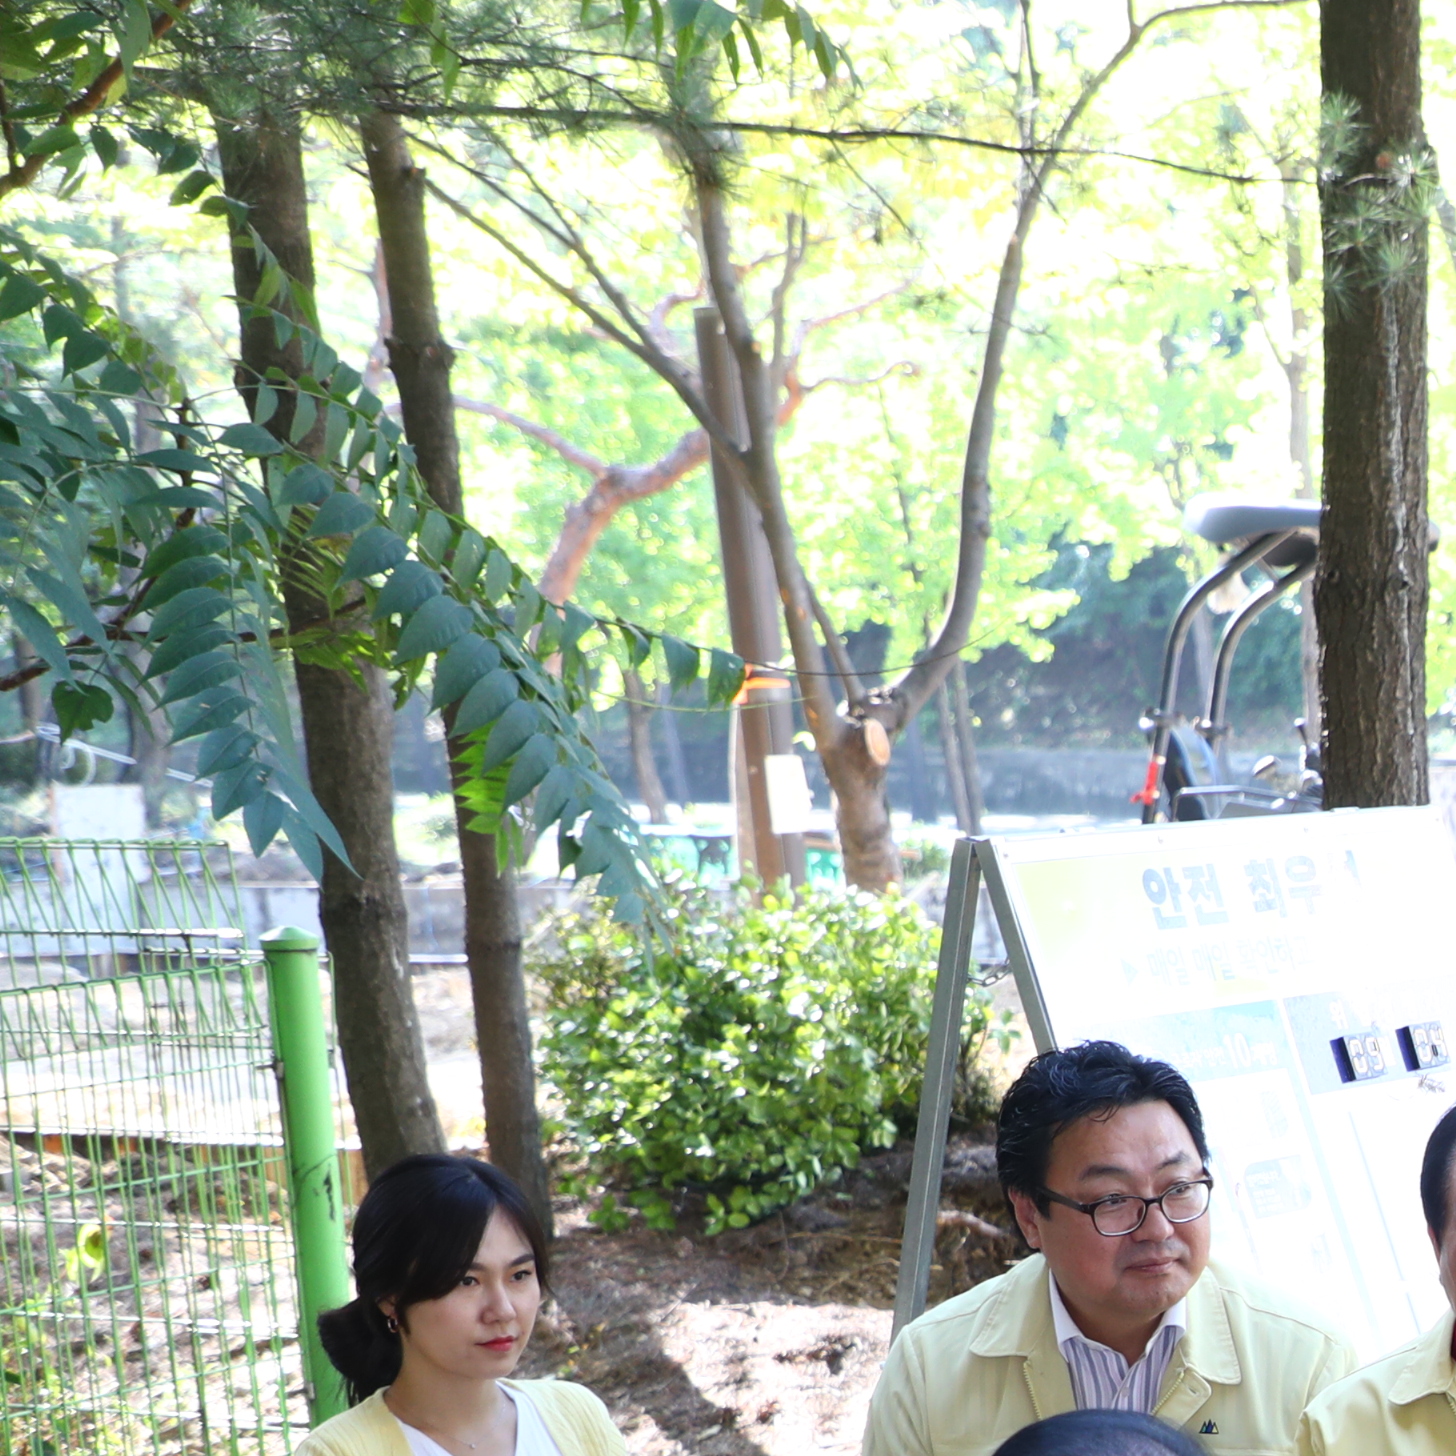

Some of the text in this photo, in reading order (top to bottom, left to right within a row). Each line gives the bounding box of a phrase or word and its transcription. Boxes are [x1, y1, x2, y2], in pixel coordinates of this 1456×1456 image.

[1141, 849, 1364, 931] 안전 최우
[1146, 945, 1191, 987] 매일
[1191, 940, 1237, 982] 매일
